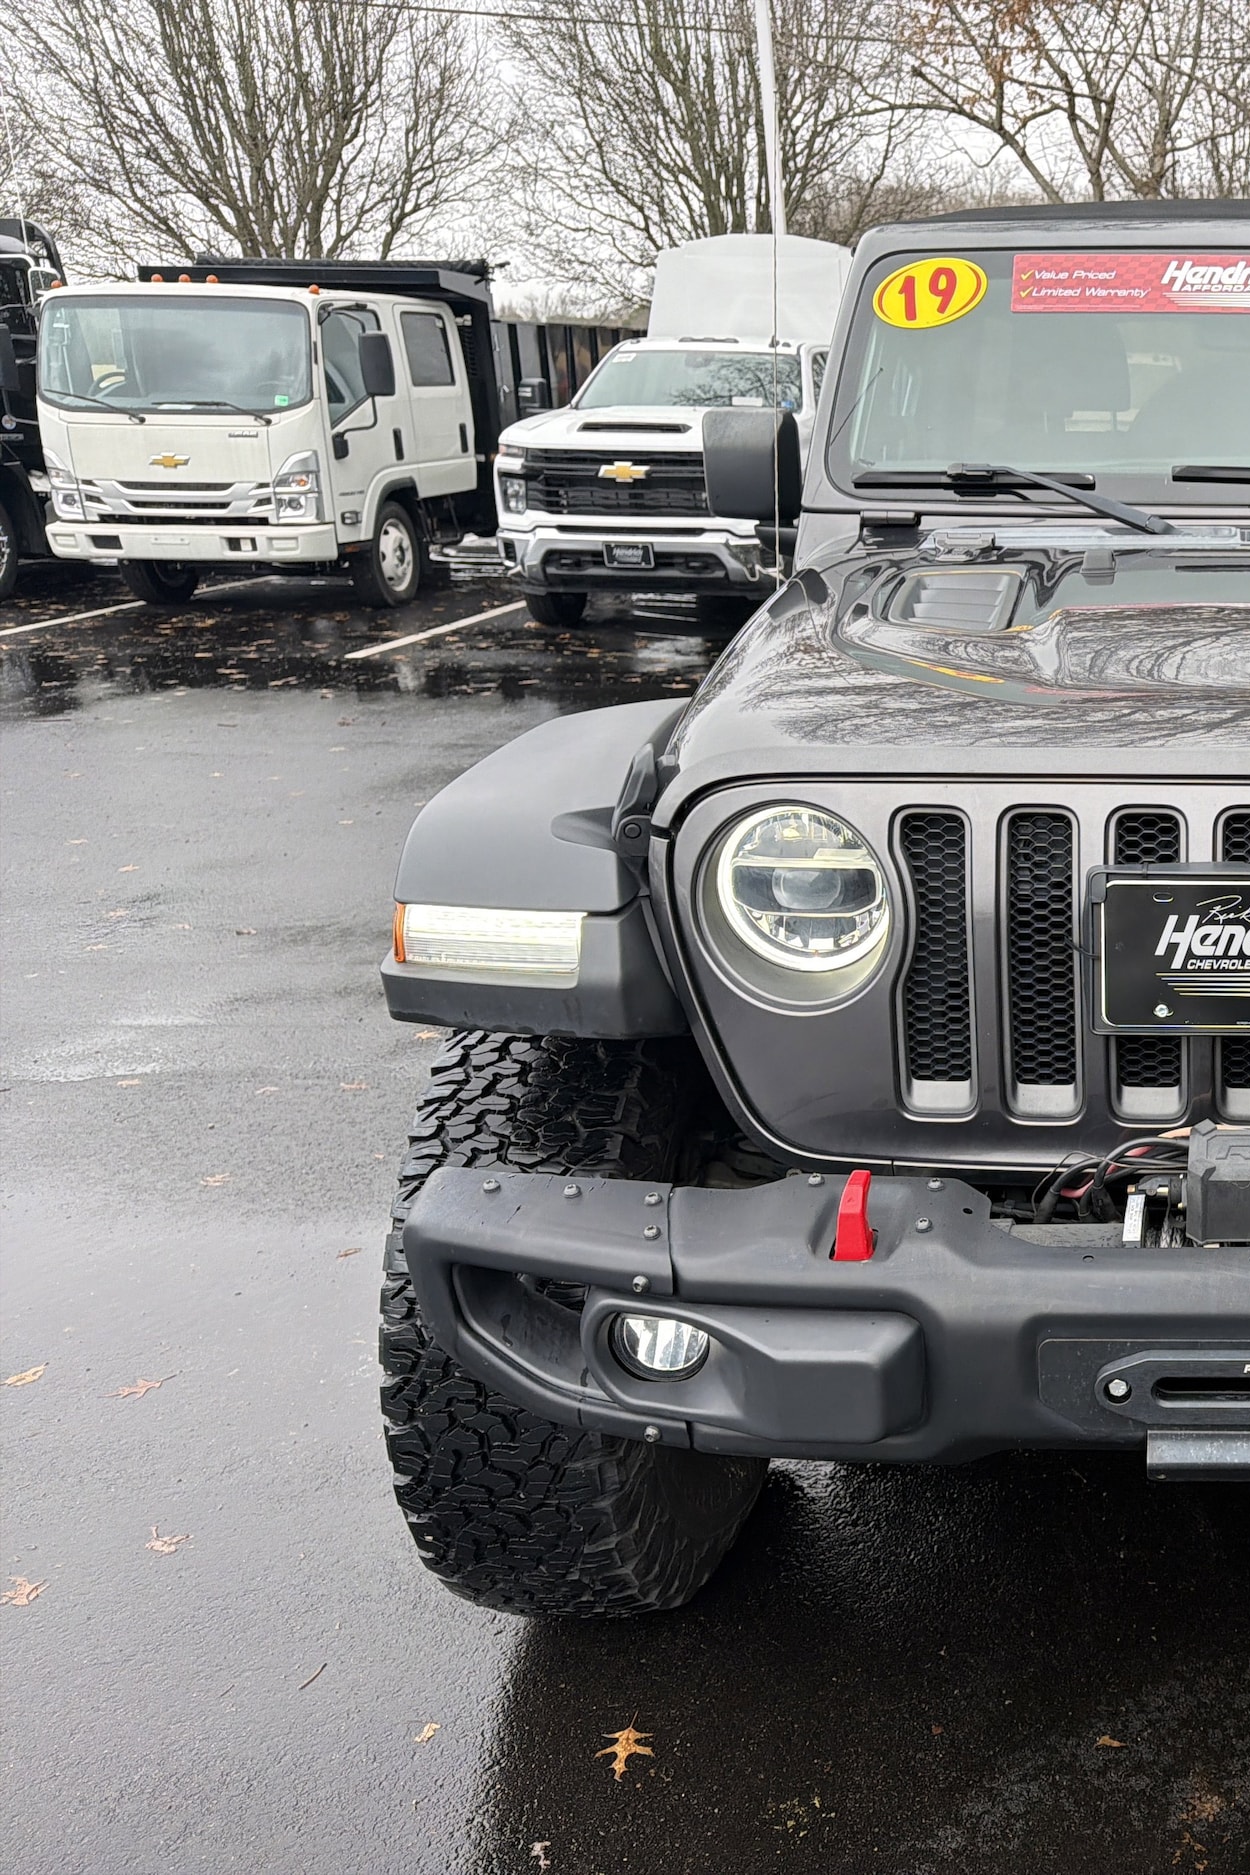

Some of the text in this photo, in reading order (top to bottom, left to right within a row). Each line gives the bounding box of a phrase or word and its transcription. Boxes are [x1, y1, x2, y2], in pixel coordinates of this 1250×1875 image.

[1034, 270, 1116, 280] Value Priced
[897, 266, 957, 321] 19
[1032, 287, 1081, 297] Limited
